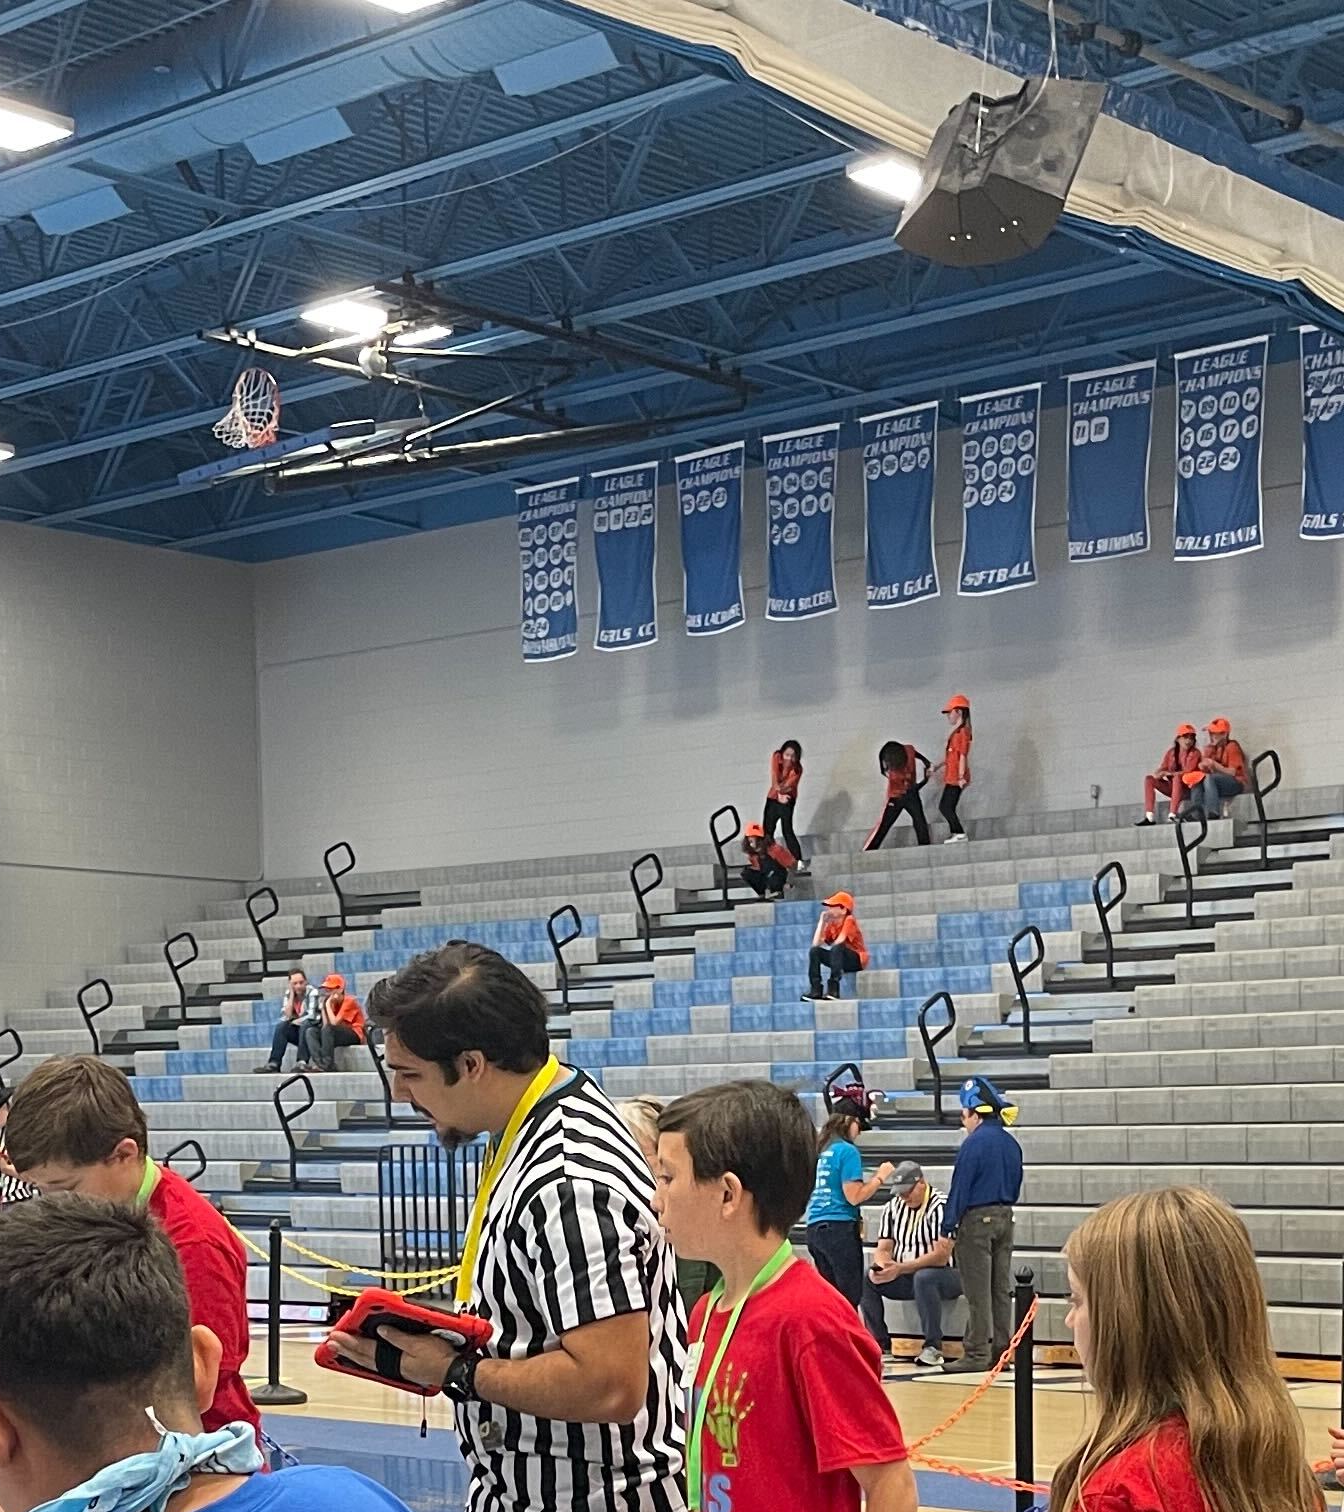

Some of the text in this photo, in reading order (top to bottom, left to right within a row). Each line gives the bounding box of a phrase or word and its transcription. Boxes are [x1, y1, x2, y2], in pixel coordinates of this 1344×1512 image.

[1193, 350, 1249, 374] LEAGUE
[1086, 375, 1136, 397] LEAGUE
[1179, 366, 1262, 393] CHAMPIONS
[976, 396, 1024, 417] LEAGUE
[1073, 391, 1151, 416] CHAMPIONS
[1222, 397, 1236, 409] 10
[876, 414, 922, 438] LEAGUE
[964, 410, 1035, 436] CHAMPIONS
[1222, 424, 1237, 437] 17
[778, 434, 825, 453] LEAGUE
[689, 453, 731, 474] LEAGUE
[768, 449, 834, 470] CHAMPIONS
[1199, 453, 1238, 469] 22 24
[605, 473, 644, 492] LEAGUE
[1215, 525, 1257, 547] TENNIS
